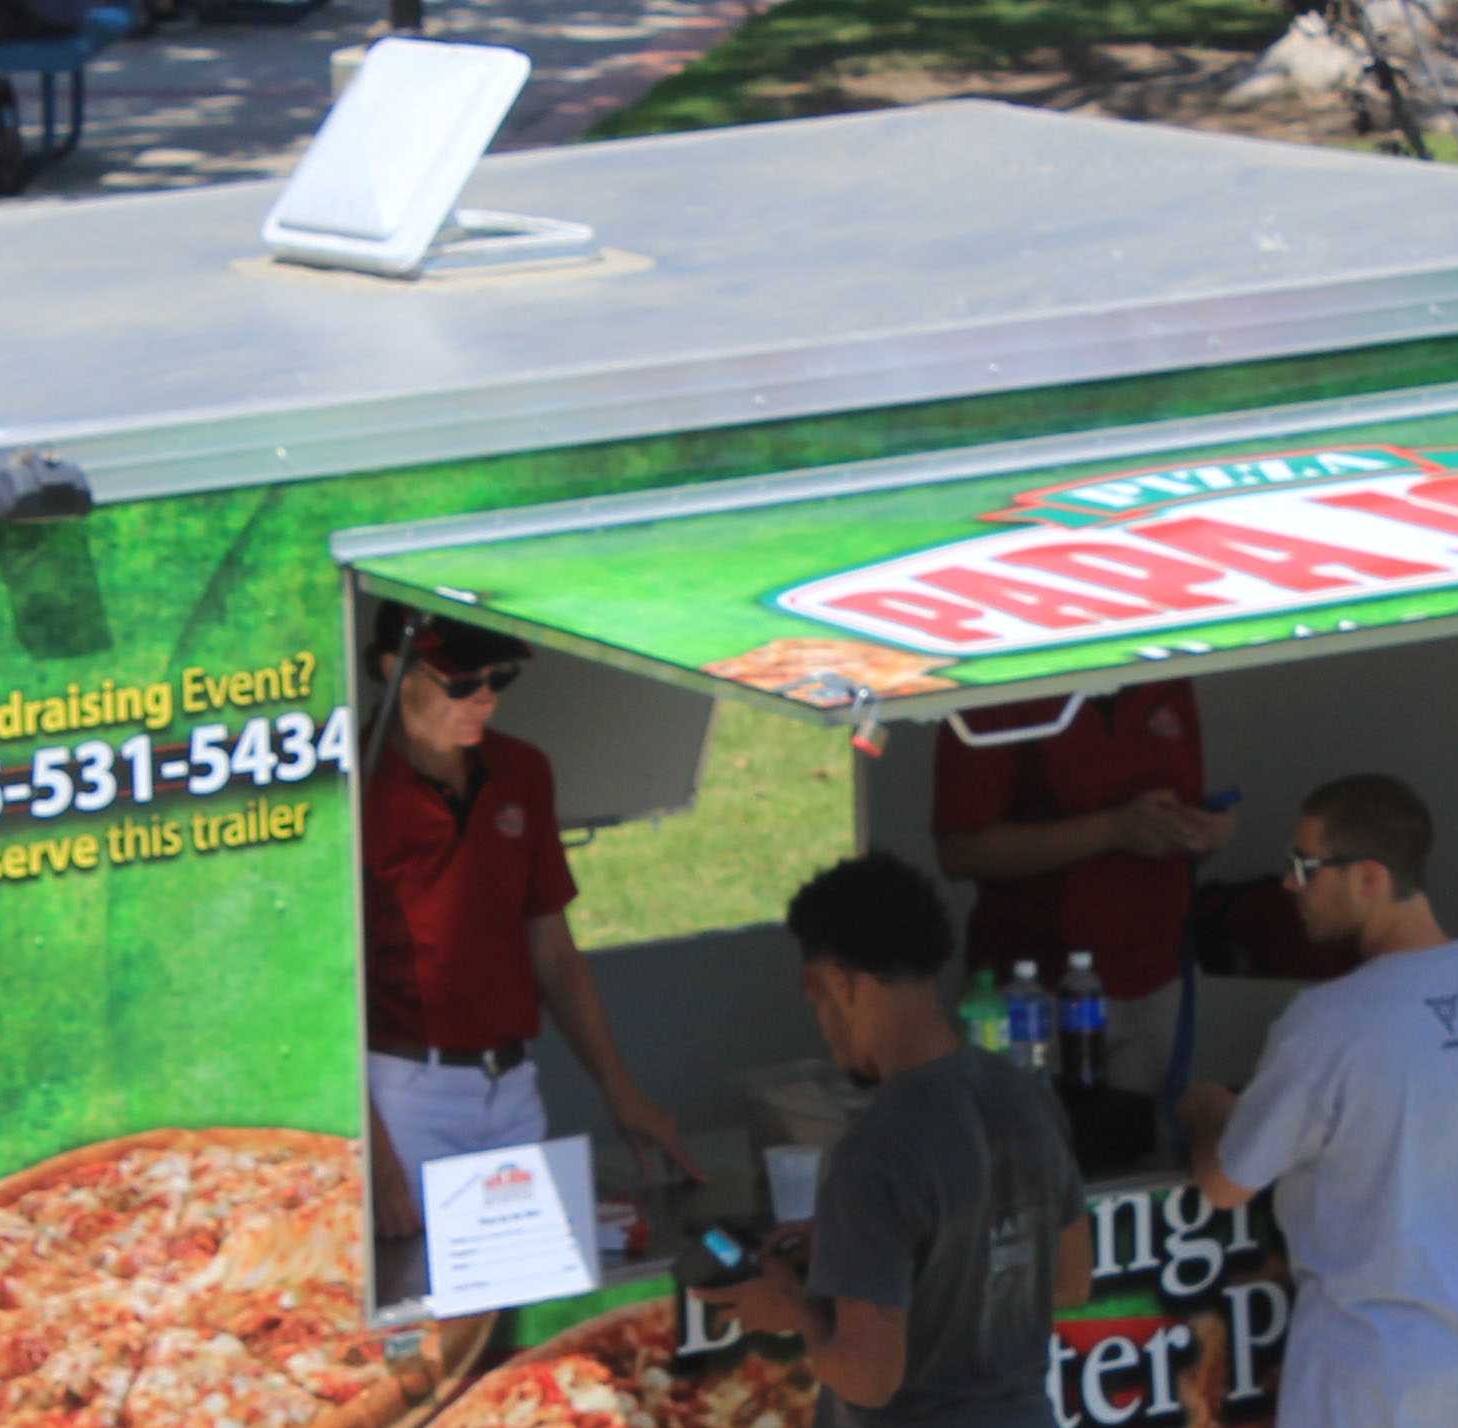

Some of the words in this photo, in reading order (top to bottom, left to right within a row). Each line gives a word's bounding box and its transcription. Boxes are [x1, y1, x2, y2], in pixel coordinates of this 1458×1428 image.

[819, 515, 1448, 645] PAPA
[181, 652, 316, 711] Event?
[107, 820, 182, 863] this
[191, 798, 310, 847] trailer
